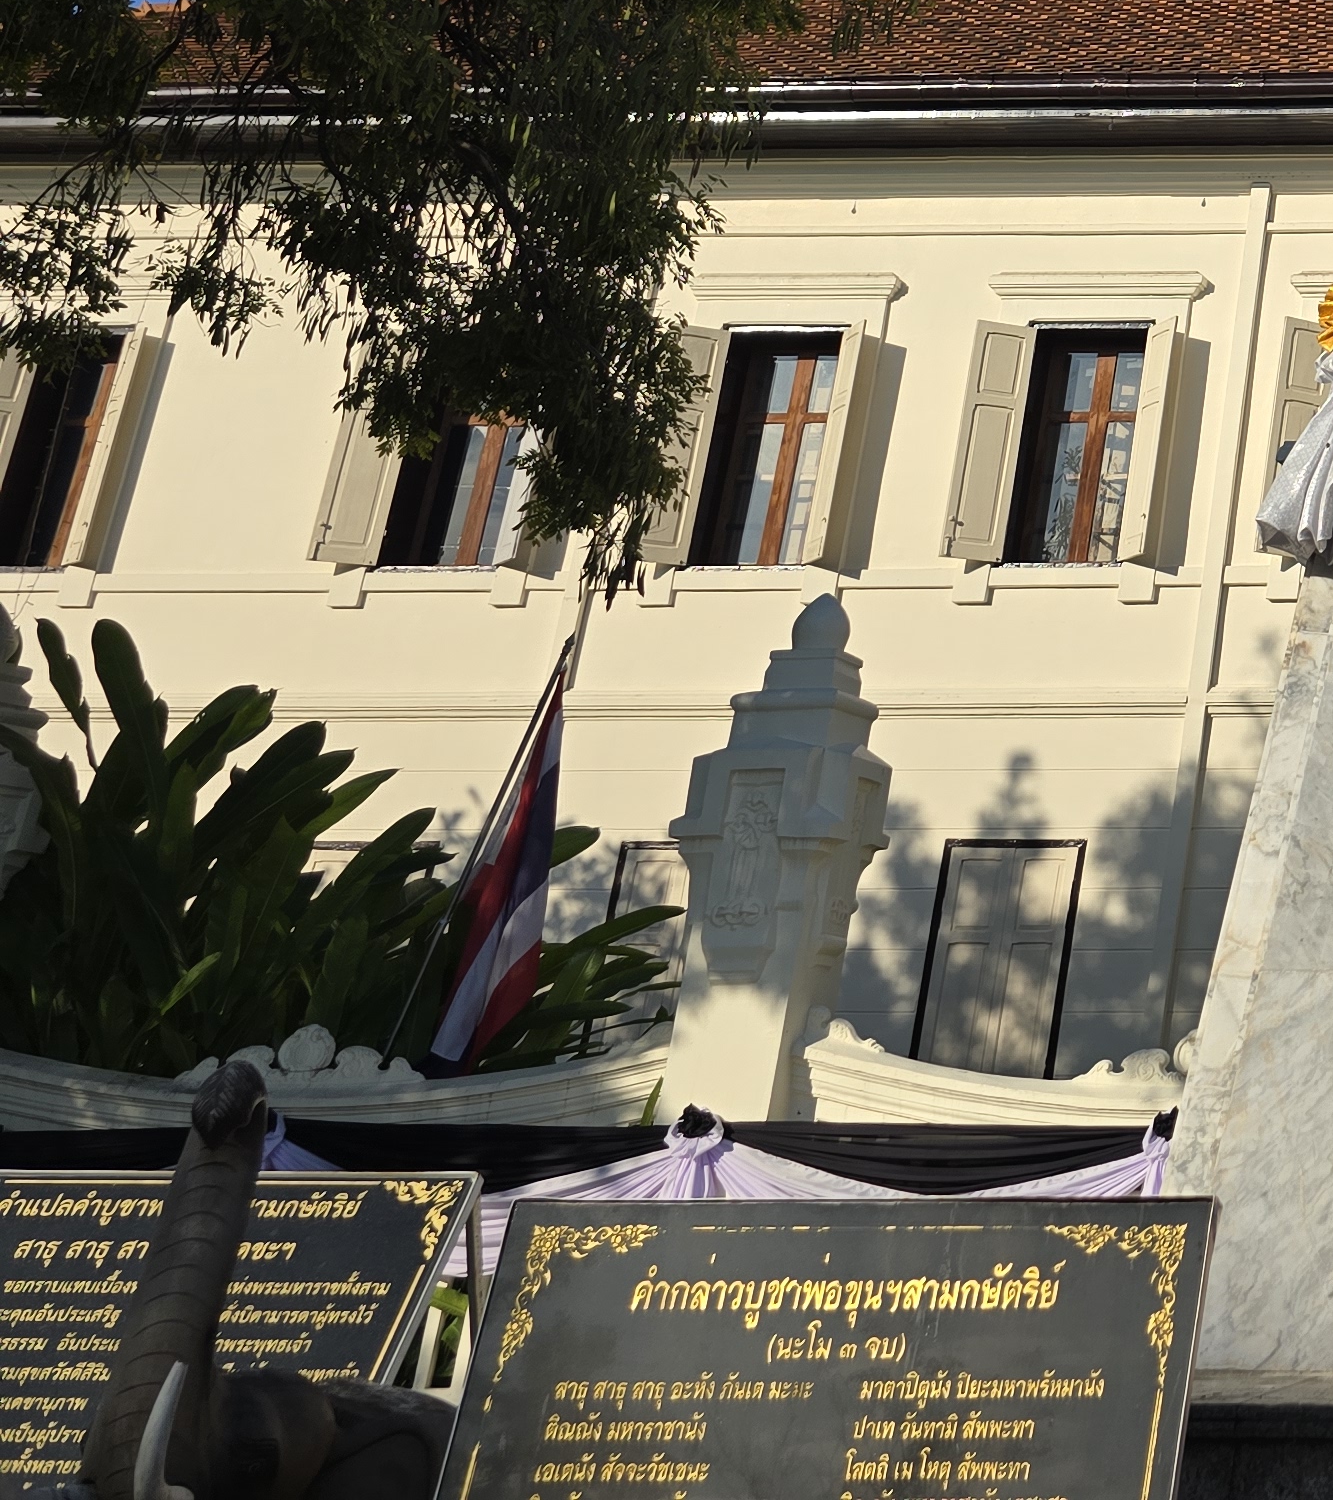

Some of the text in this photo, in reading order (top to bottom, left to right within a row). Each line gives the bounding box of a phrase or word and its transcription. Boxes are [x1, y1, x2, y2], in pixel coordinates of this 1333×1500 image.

[14, 1239, 63, 1268] สาธุ
[65, 1239, 114, 1268] สาธุ
[117, 1240, 150, 1259] สา
[766, 1320, 907, 1364] (นะโม ๓ จบ)
[0, 1396, 89, 1417] ะเดชานุภาพ
[555, 1380, 589, 1410] สาธุ
[593, 1380, 628, 1411] สาธุ
[632, 1380, 666, 1411] สาธุ
[671, 1372, 715, 1400] อะหัง
[719, 1373, 765, 1402] ภันเต
[860, 1370, 952, 1409] มาตาปิตูนัง
[544, 1411, 1035, 1441] ติณณัง มหาราชานัง ปาเท วันทามิ สัพพะทา
[534, 1447, 1031, 1491] เอเตนัง สัจจะวัชเชนะ โสตถิ เม โหตุ สัพพะทา
